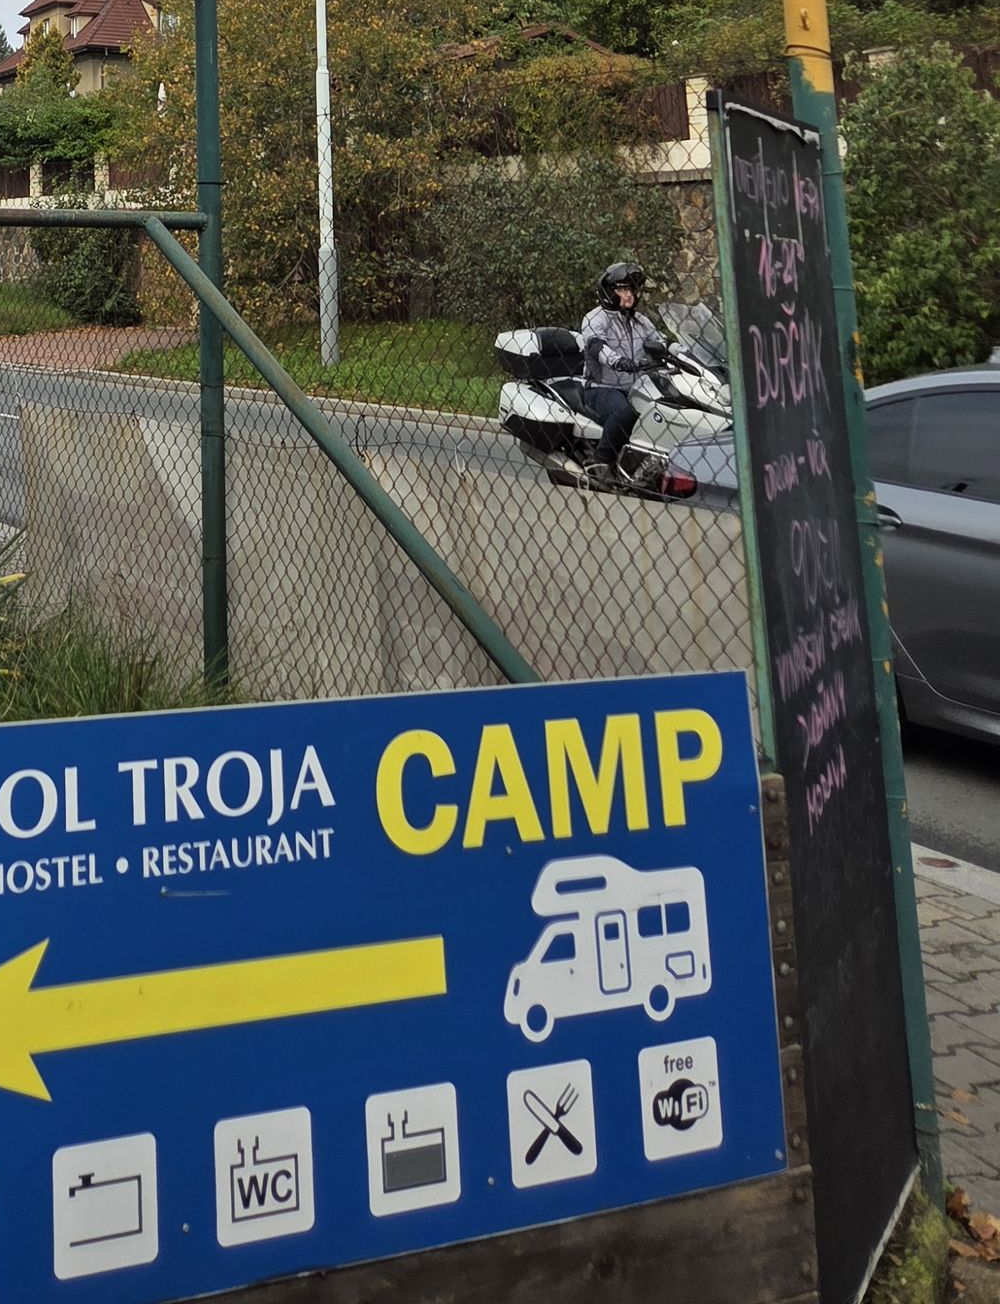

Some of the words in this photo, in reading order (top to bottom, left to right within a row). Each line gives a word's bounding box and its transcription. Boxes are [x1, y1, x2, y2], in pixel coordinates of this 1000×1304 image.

[118, 744, 337, 826] TROJA
[376, 708, 723, 856] CAMP
[142, 827, 335, 879] RESTAURANT
[664, 1054, 694, 1074] free
[237, 1169, 294, 1210] WC
